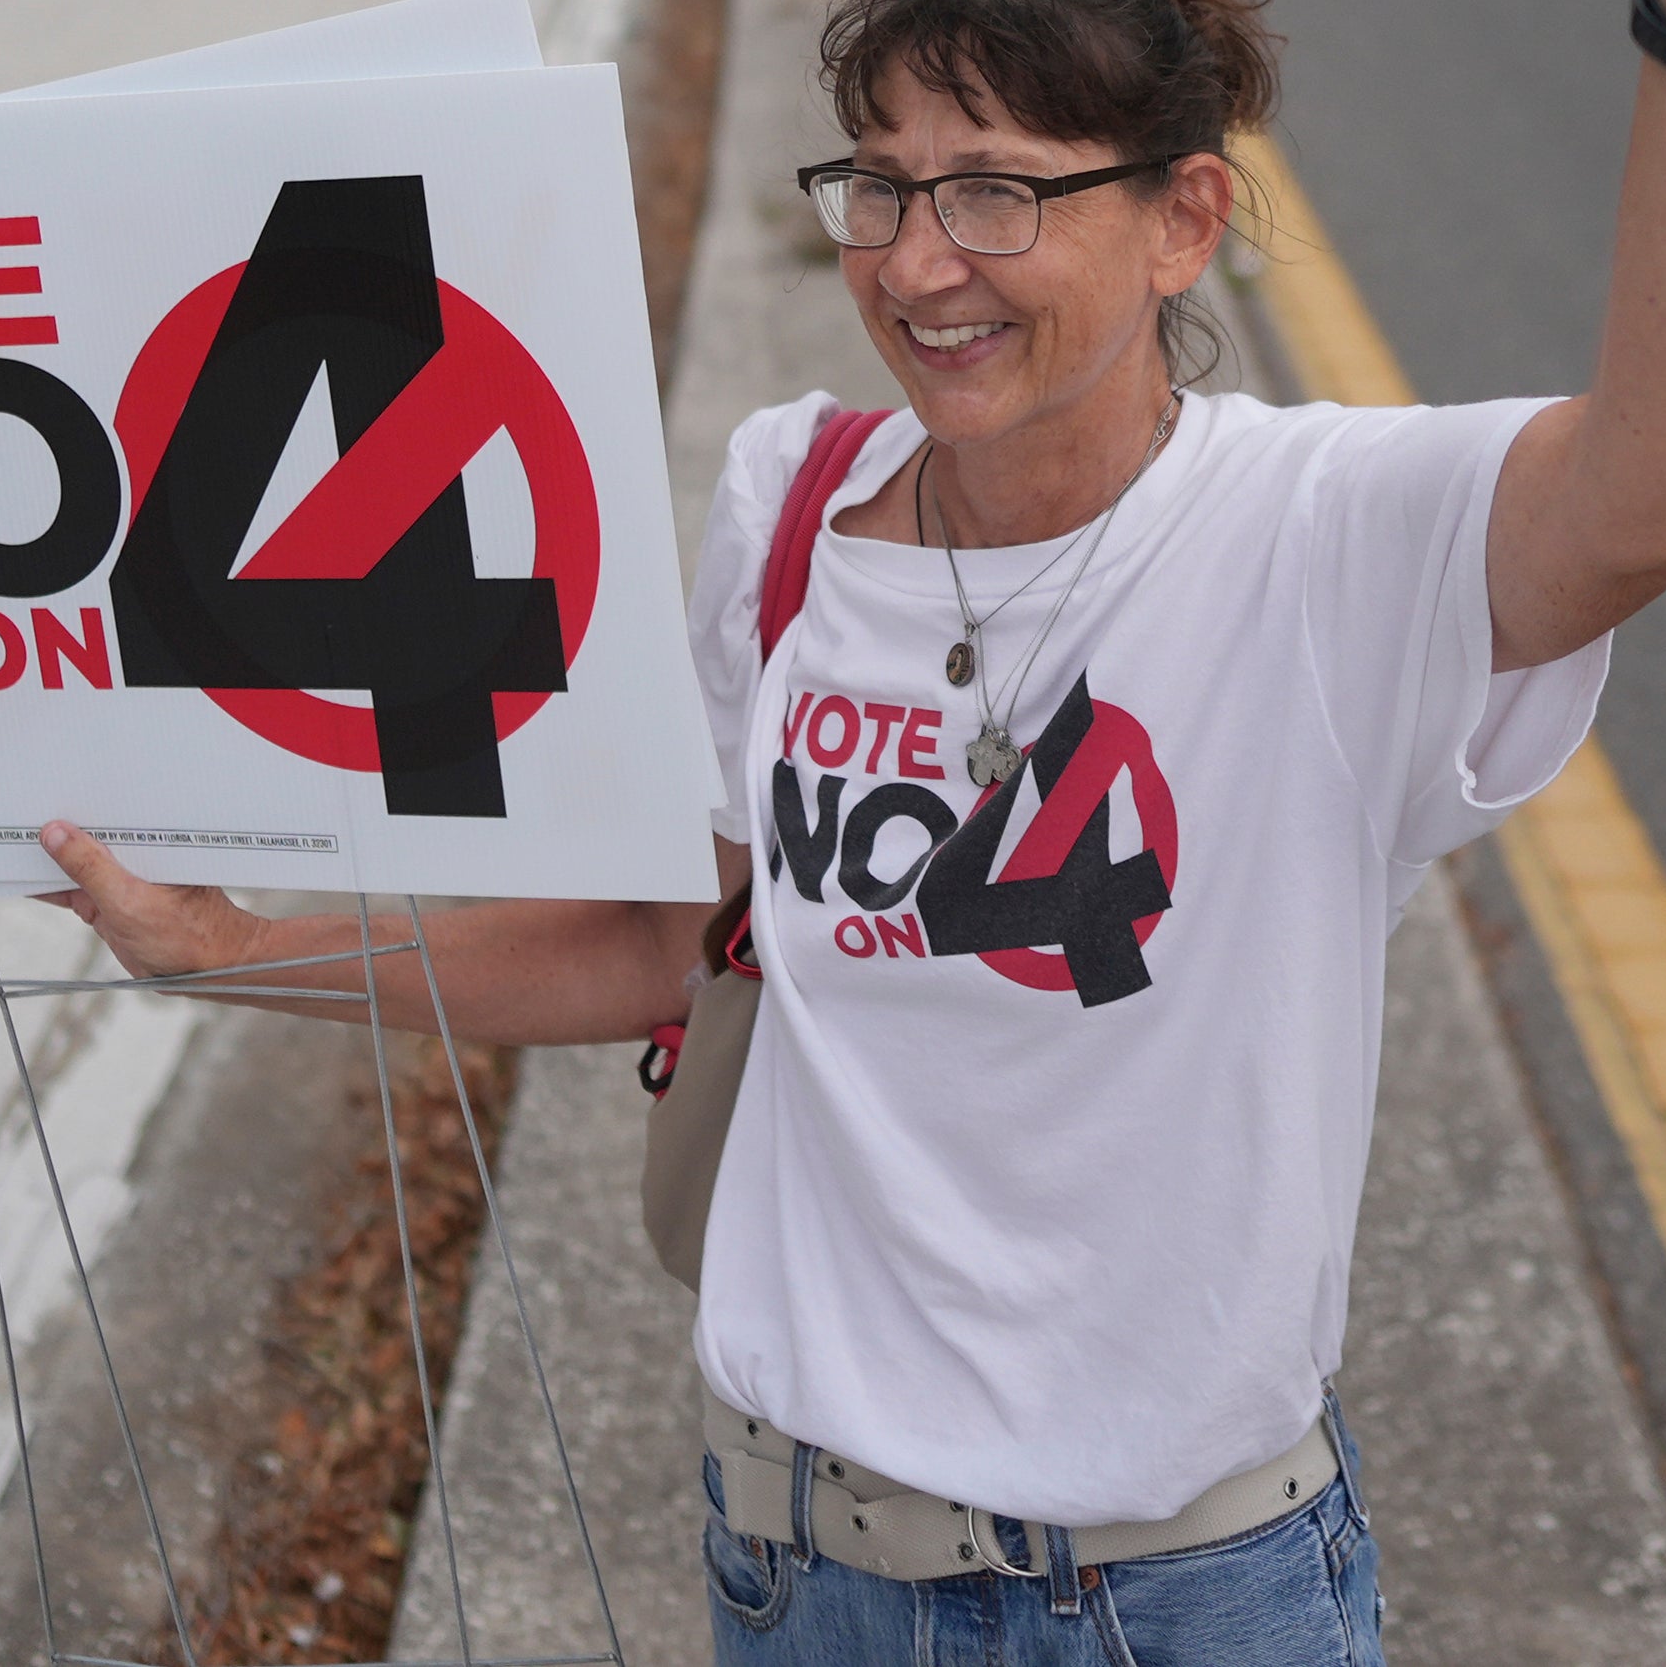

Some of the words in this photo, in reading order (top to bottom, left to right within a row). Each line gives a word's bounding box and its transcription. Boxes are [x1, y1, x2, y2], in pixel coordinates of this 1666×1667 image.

[109, 174, 569, 818] 4
[784, 691, 946, 780] VOTE
[94, 831, 107, 840] FOR
[108, 831, 118, 840] BY
[118, 832, 135, 841] VOTE
[136, 832, 146, 842] NO
[147, 832, 157, 842] ON
[210, 834, 229, 845] HAYS
[229, 835, 255, 846] STREET,
[302, 837, 311, 848] FL
[311, 838, 332, 849] 32301
[769, 757, 959, 912] NO
[916, 667, 1173, 1009] 4
[834, 913, 926, 958] ON
